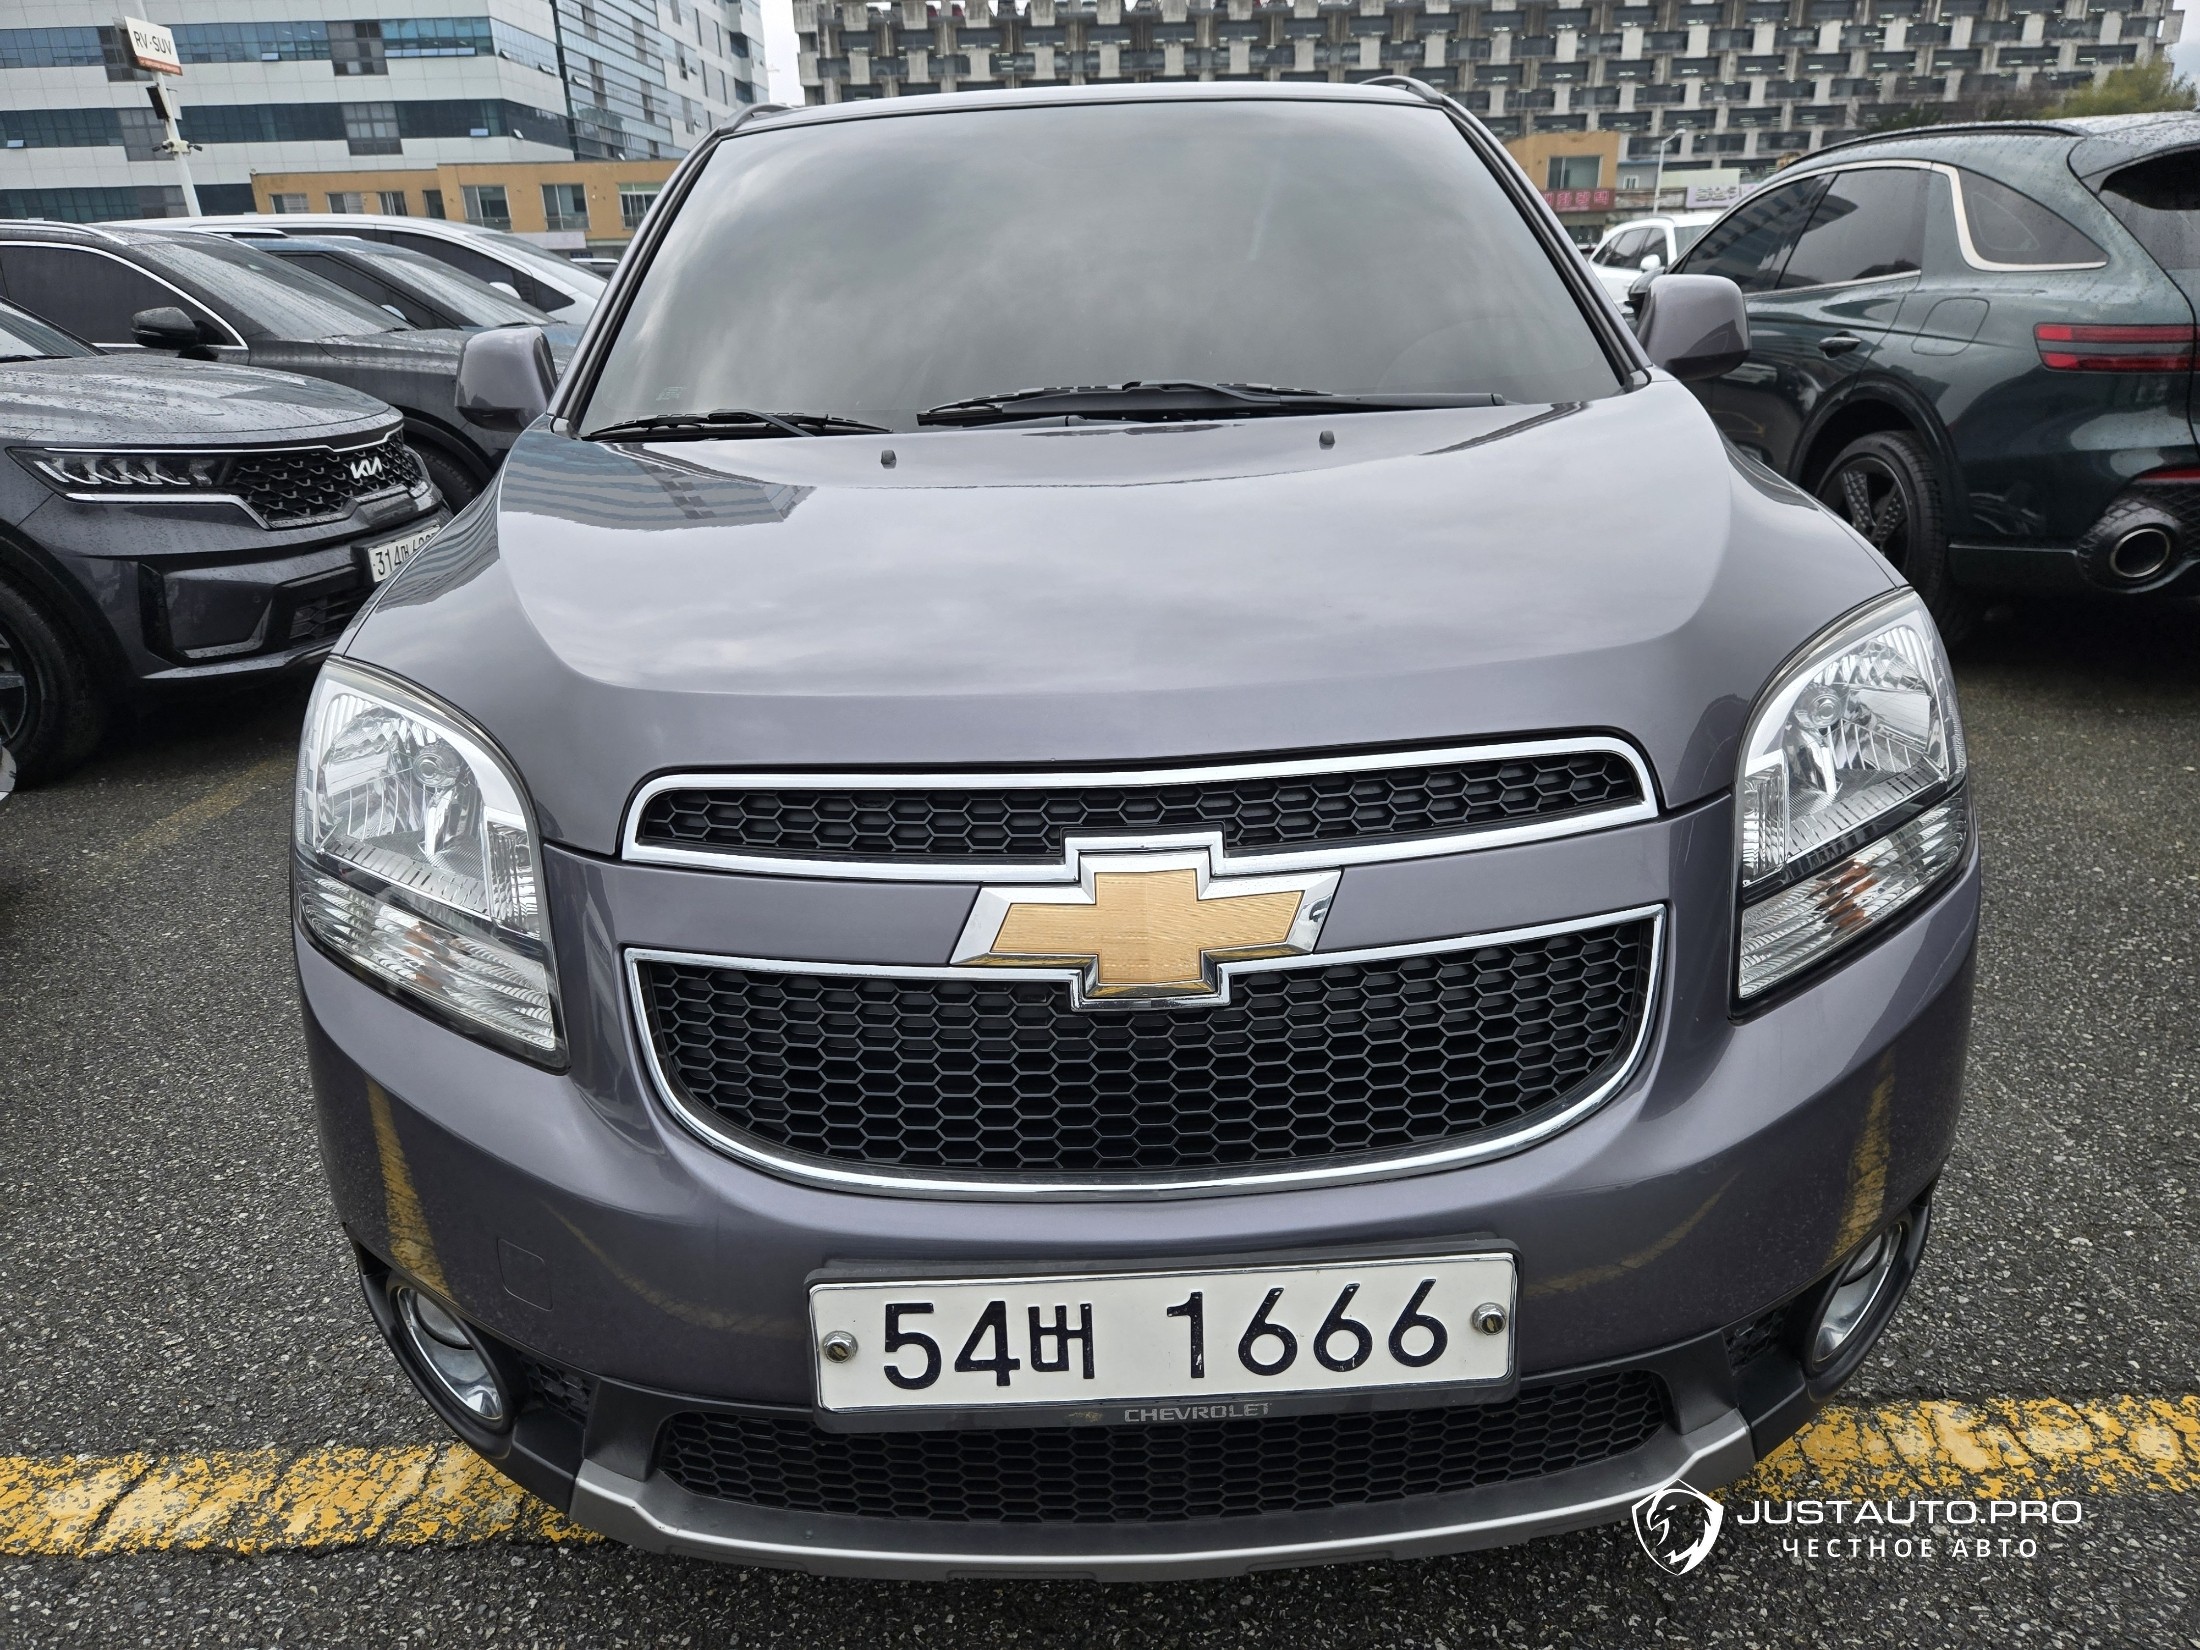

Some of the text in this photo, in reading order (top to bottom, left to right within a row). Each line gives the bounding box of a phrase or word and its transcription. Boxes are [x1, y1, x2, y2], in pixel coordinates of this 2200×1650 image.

[883, 1278, 1448, 1390] 54버 1666
[1124, 1402, 1271, 1422] CHEVROLET
